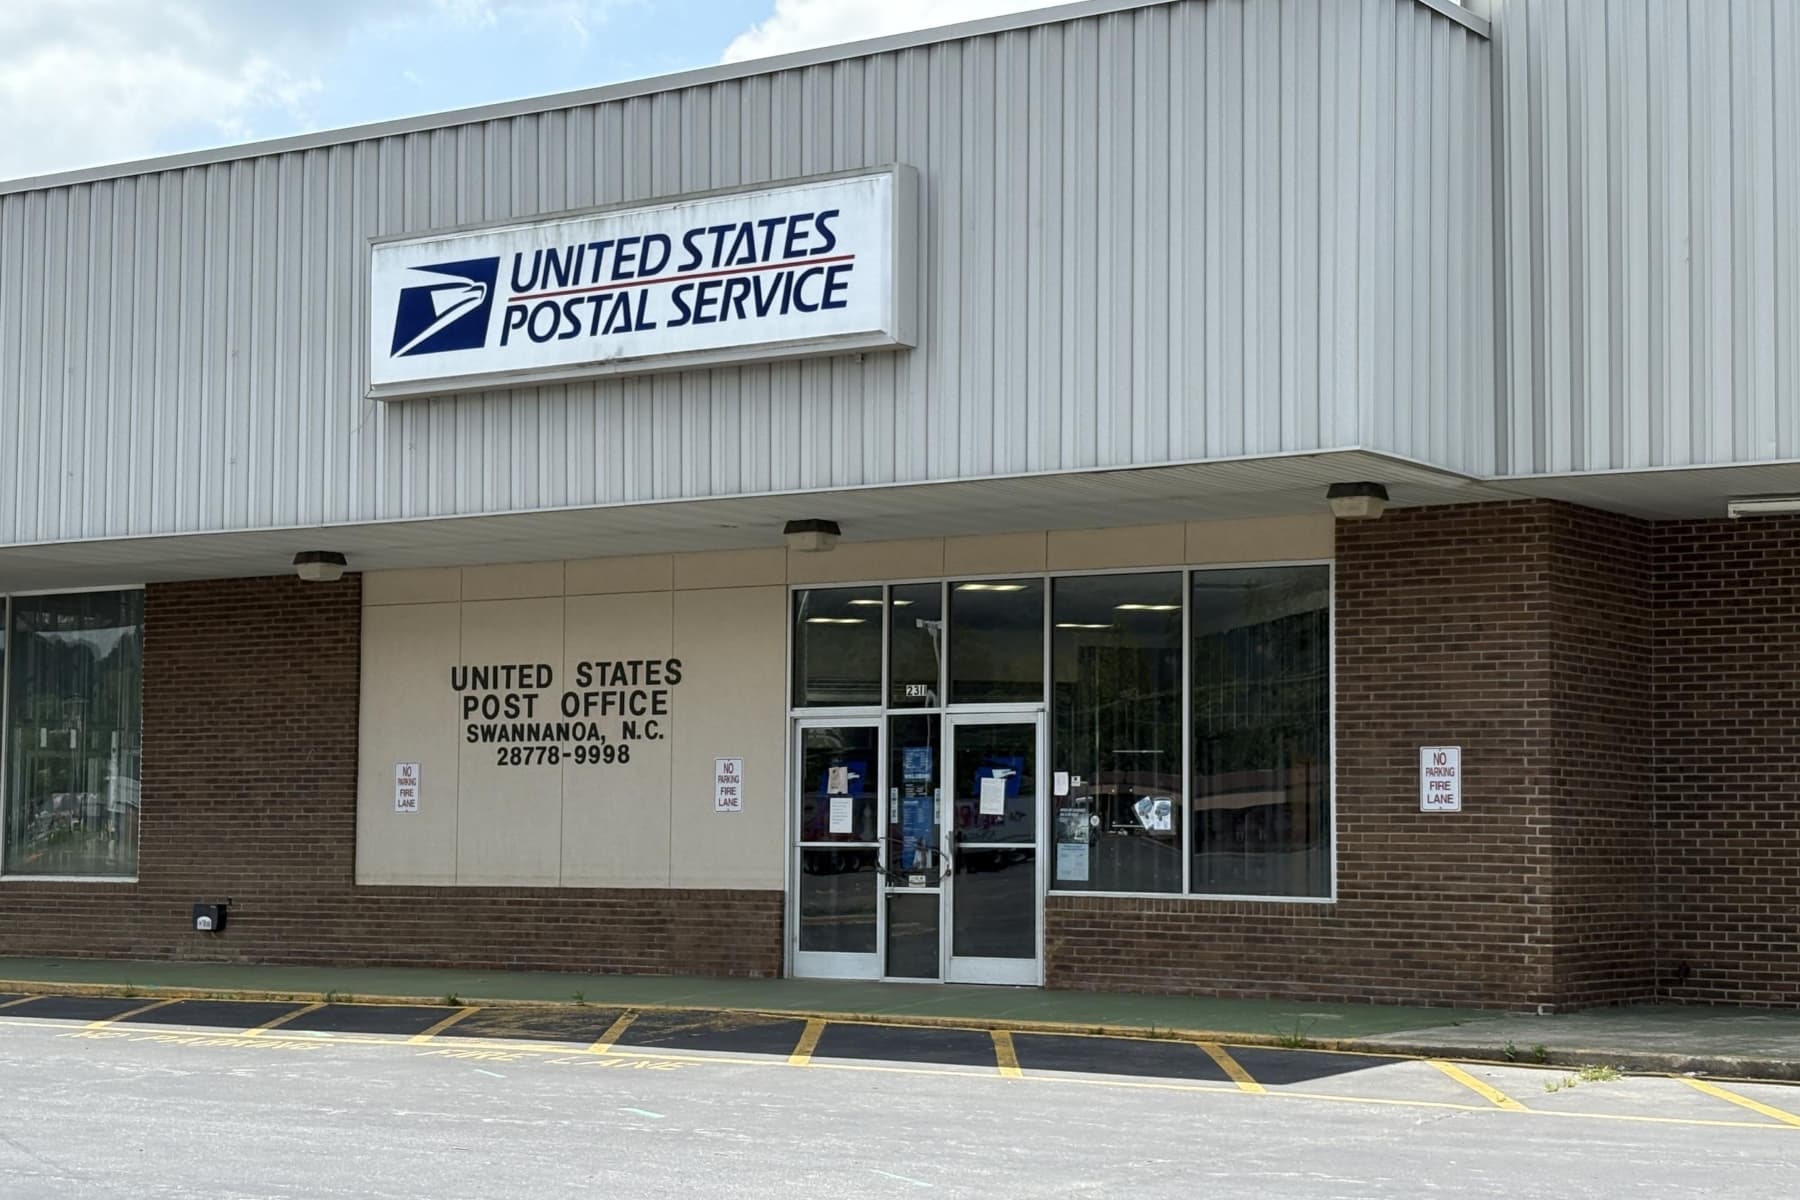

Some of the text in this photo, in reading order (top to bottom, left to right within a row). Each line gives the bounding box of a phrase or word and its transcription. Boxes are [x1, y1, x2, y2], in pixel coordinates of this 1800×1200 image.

[510, 210, 839, 294] UNITED STATES
[500, 264, 854, 347] POSTAL SERVICE
[451, 659, 682, 691] UNITED STATES
[463, 690, 668, 720] POST OFFICE
[466, 720, 664, 745] SWANNANOA, N.C.
[497, 745, 630, 766] 28778-9998
[1433, 752, 1447, 765] NO
[403, 766, 412, 777] NO
[724, 762, 734, 774] NO
[1426, 767, 1455, 776] PARKING
[718, 775, 740, 784] PARKING
[1430, 781, 1451, 790] FIRE
[400, 789, 414, 797] FIRE
[721, 787, 736, 795] FIRE
[719, 798, 739, 806] LANE
[1427, 794, 1454, 804] LANE
[56, 1031, 701, 1071] NO PARKING FIRE LANE
